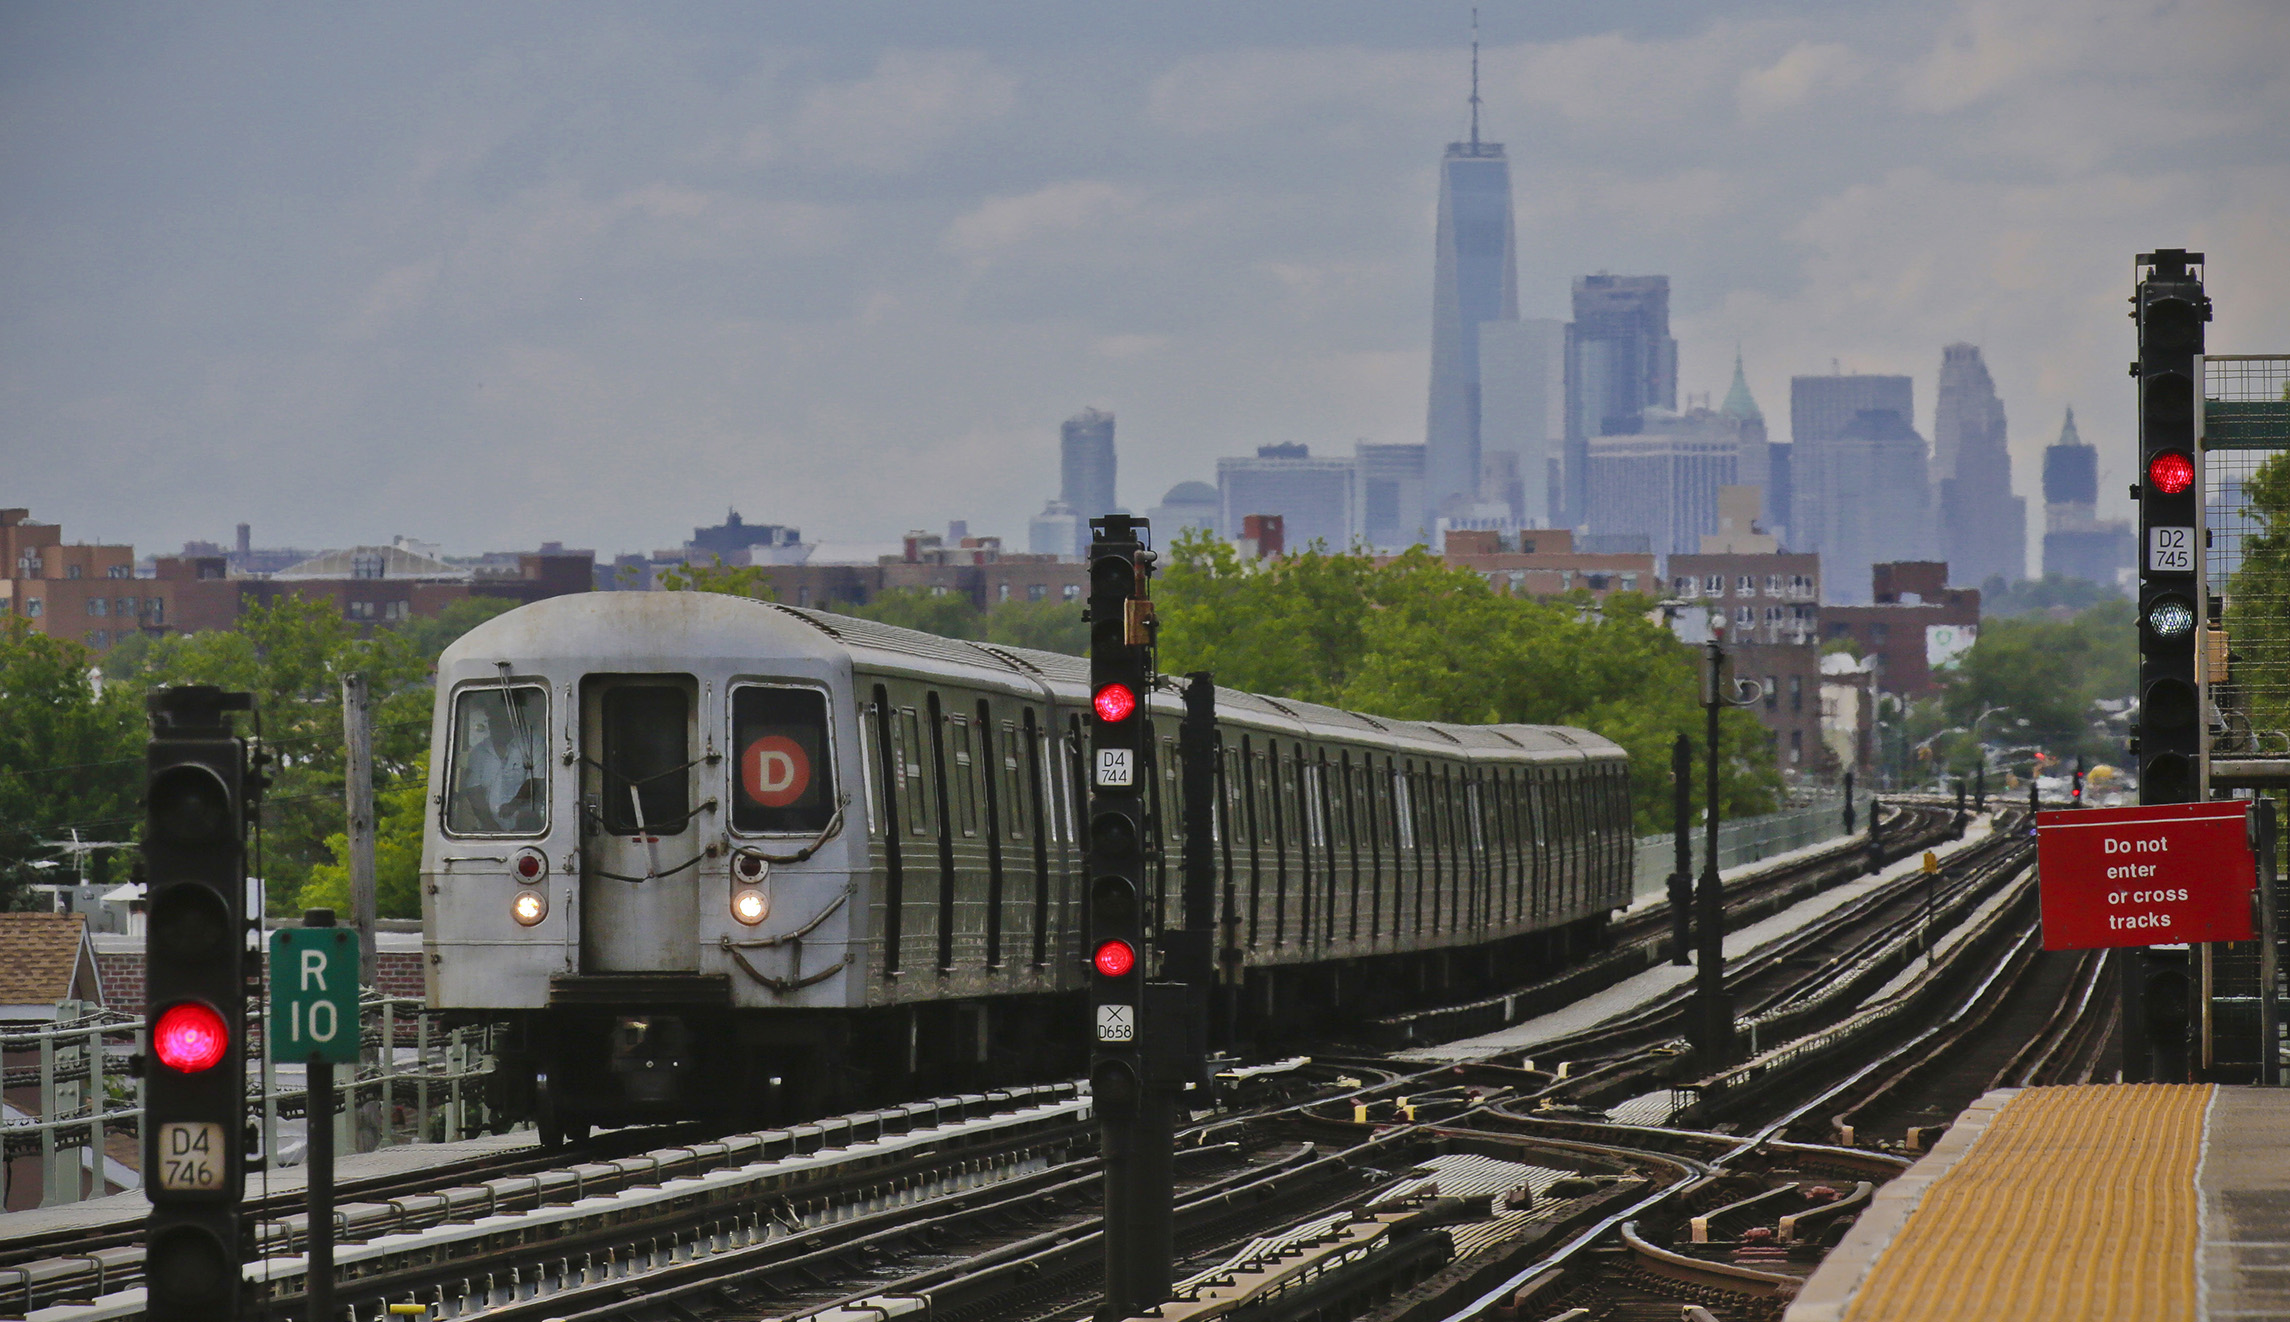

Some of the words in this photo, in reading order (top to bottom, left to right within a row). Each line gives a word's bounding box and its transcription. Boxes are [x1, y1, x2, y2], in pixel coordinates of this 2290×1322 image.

[2159, 529, 2185, 548] D2
[2156, 550, 2188, 568] 745
[1103, 752, 1125, 767] D4
[759, 750, 795, 792] D
[1102, 769, 1127, 783] 744
[2104, 838, 2132, 854] Do
[2136, 836, 2168, 853] not
[2106, 863, 2157, 880] enter
[2107, 891, 2129, 905] or
[2133, 887, 2189, 904] cross
[2109, 911, 2172, 930] tracks
[300, 949, 328, 992] R
[291, 999, 338, 1043] 10
[1098, 1024, 1132, 1039] D658
[171, 1127, 210, 1156] D4
[166, 1159, 214, 1187] 746
